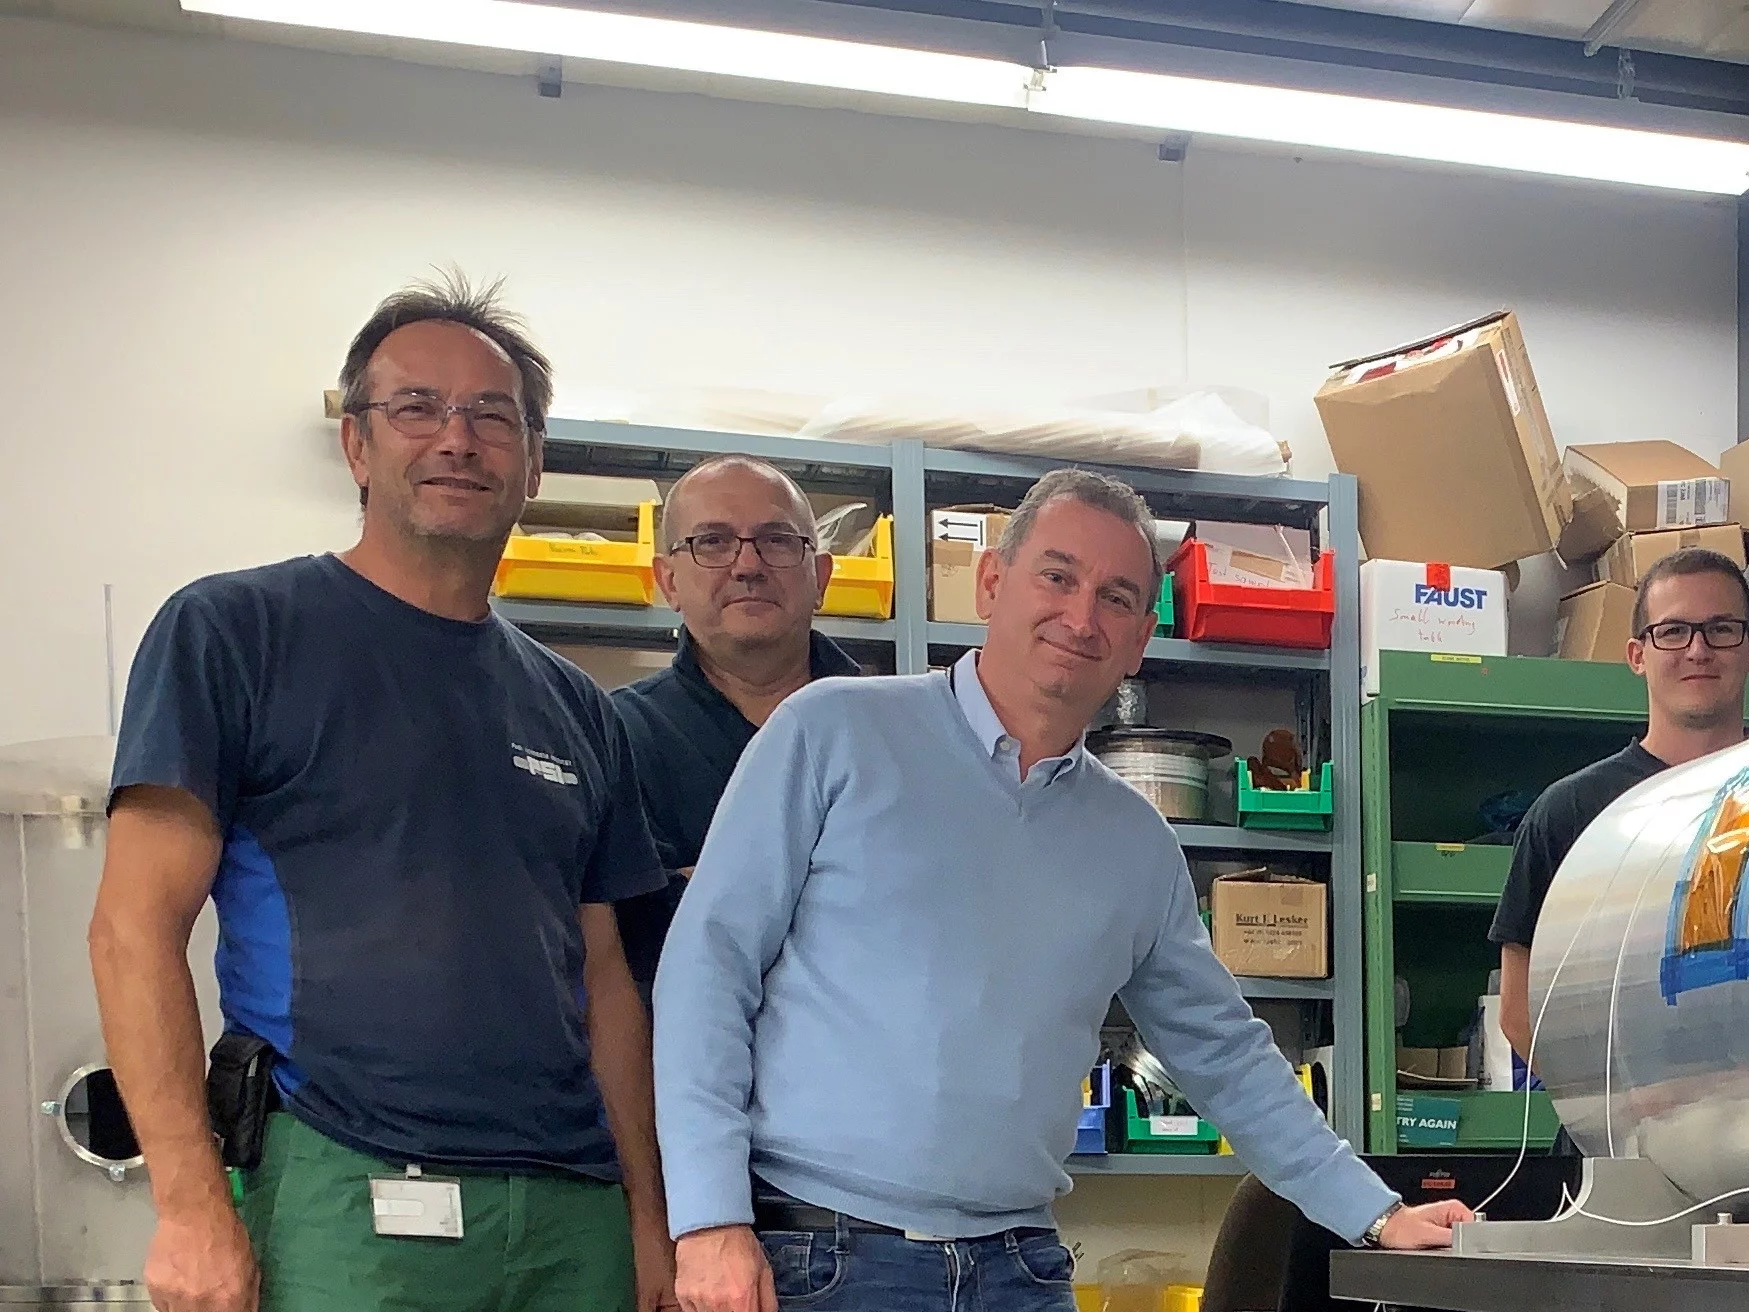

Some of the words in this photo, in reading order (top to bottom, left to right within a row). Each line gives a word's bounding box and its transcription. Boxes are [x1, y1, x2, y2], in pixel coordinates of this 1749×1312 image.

[1415, 583, 1488, 610] FAUST
[1235, 913, 1259, 923] Kurt
[1418, 1118, 1458, 1130] AGAIN
